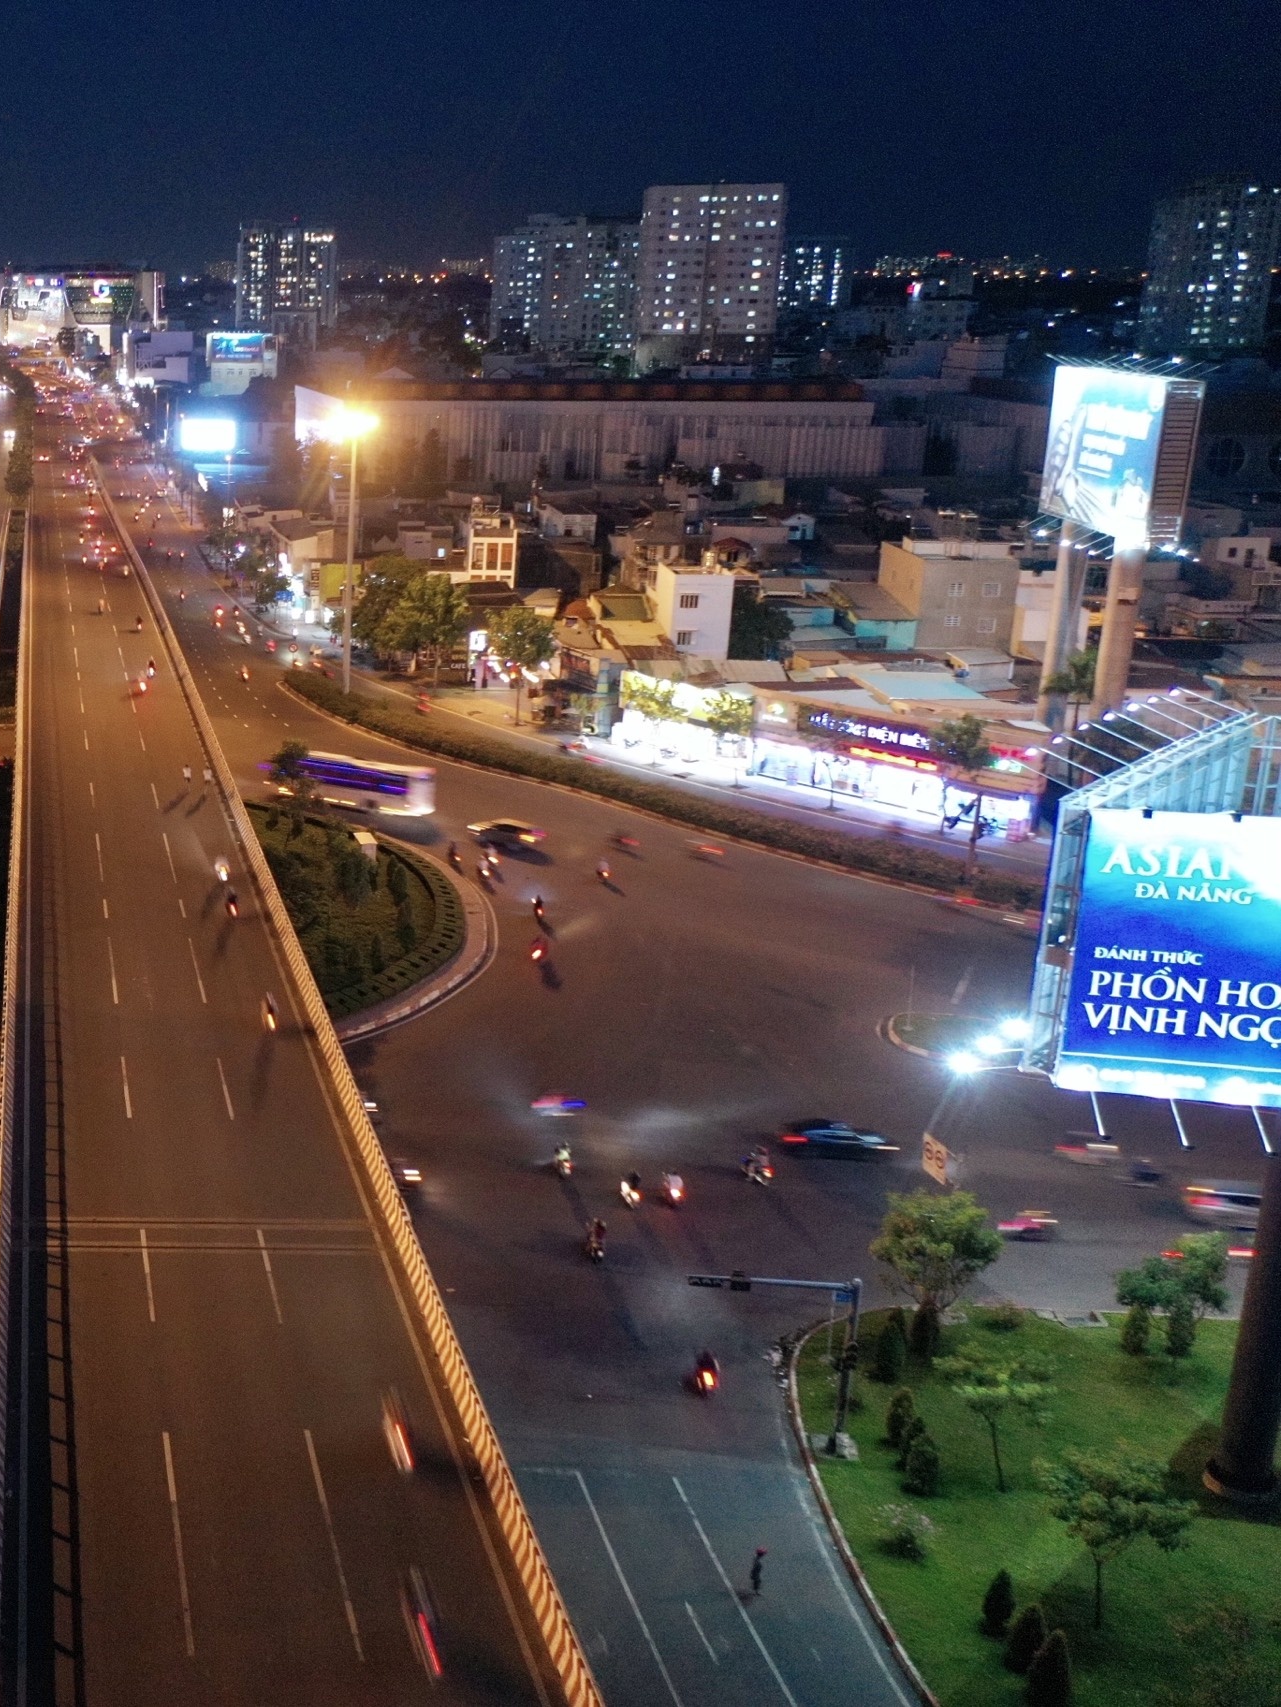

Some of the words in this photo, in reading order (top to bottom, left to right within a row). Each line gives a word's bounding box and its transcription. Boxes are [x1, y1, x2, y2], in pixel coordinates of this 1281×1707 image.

[1134, 880, 1170, 899] ĐÀ
[1094, 945, 1147, 962] ĐÁNH
[1151, 950, 1204, 966] THỨC
[1088, 966, 1208, 1004] PHỒN
[1216, 979, 1281, 1010] HO
[1082, 1002, 1188, 1035] VỊNH
